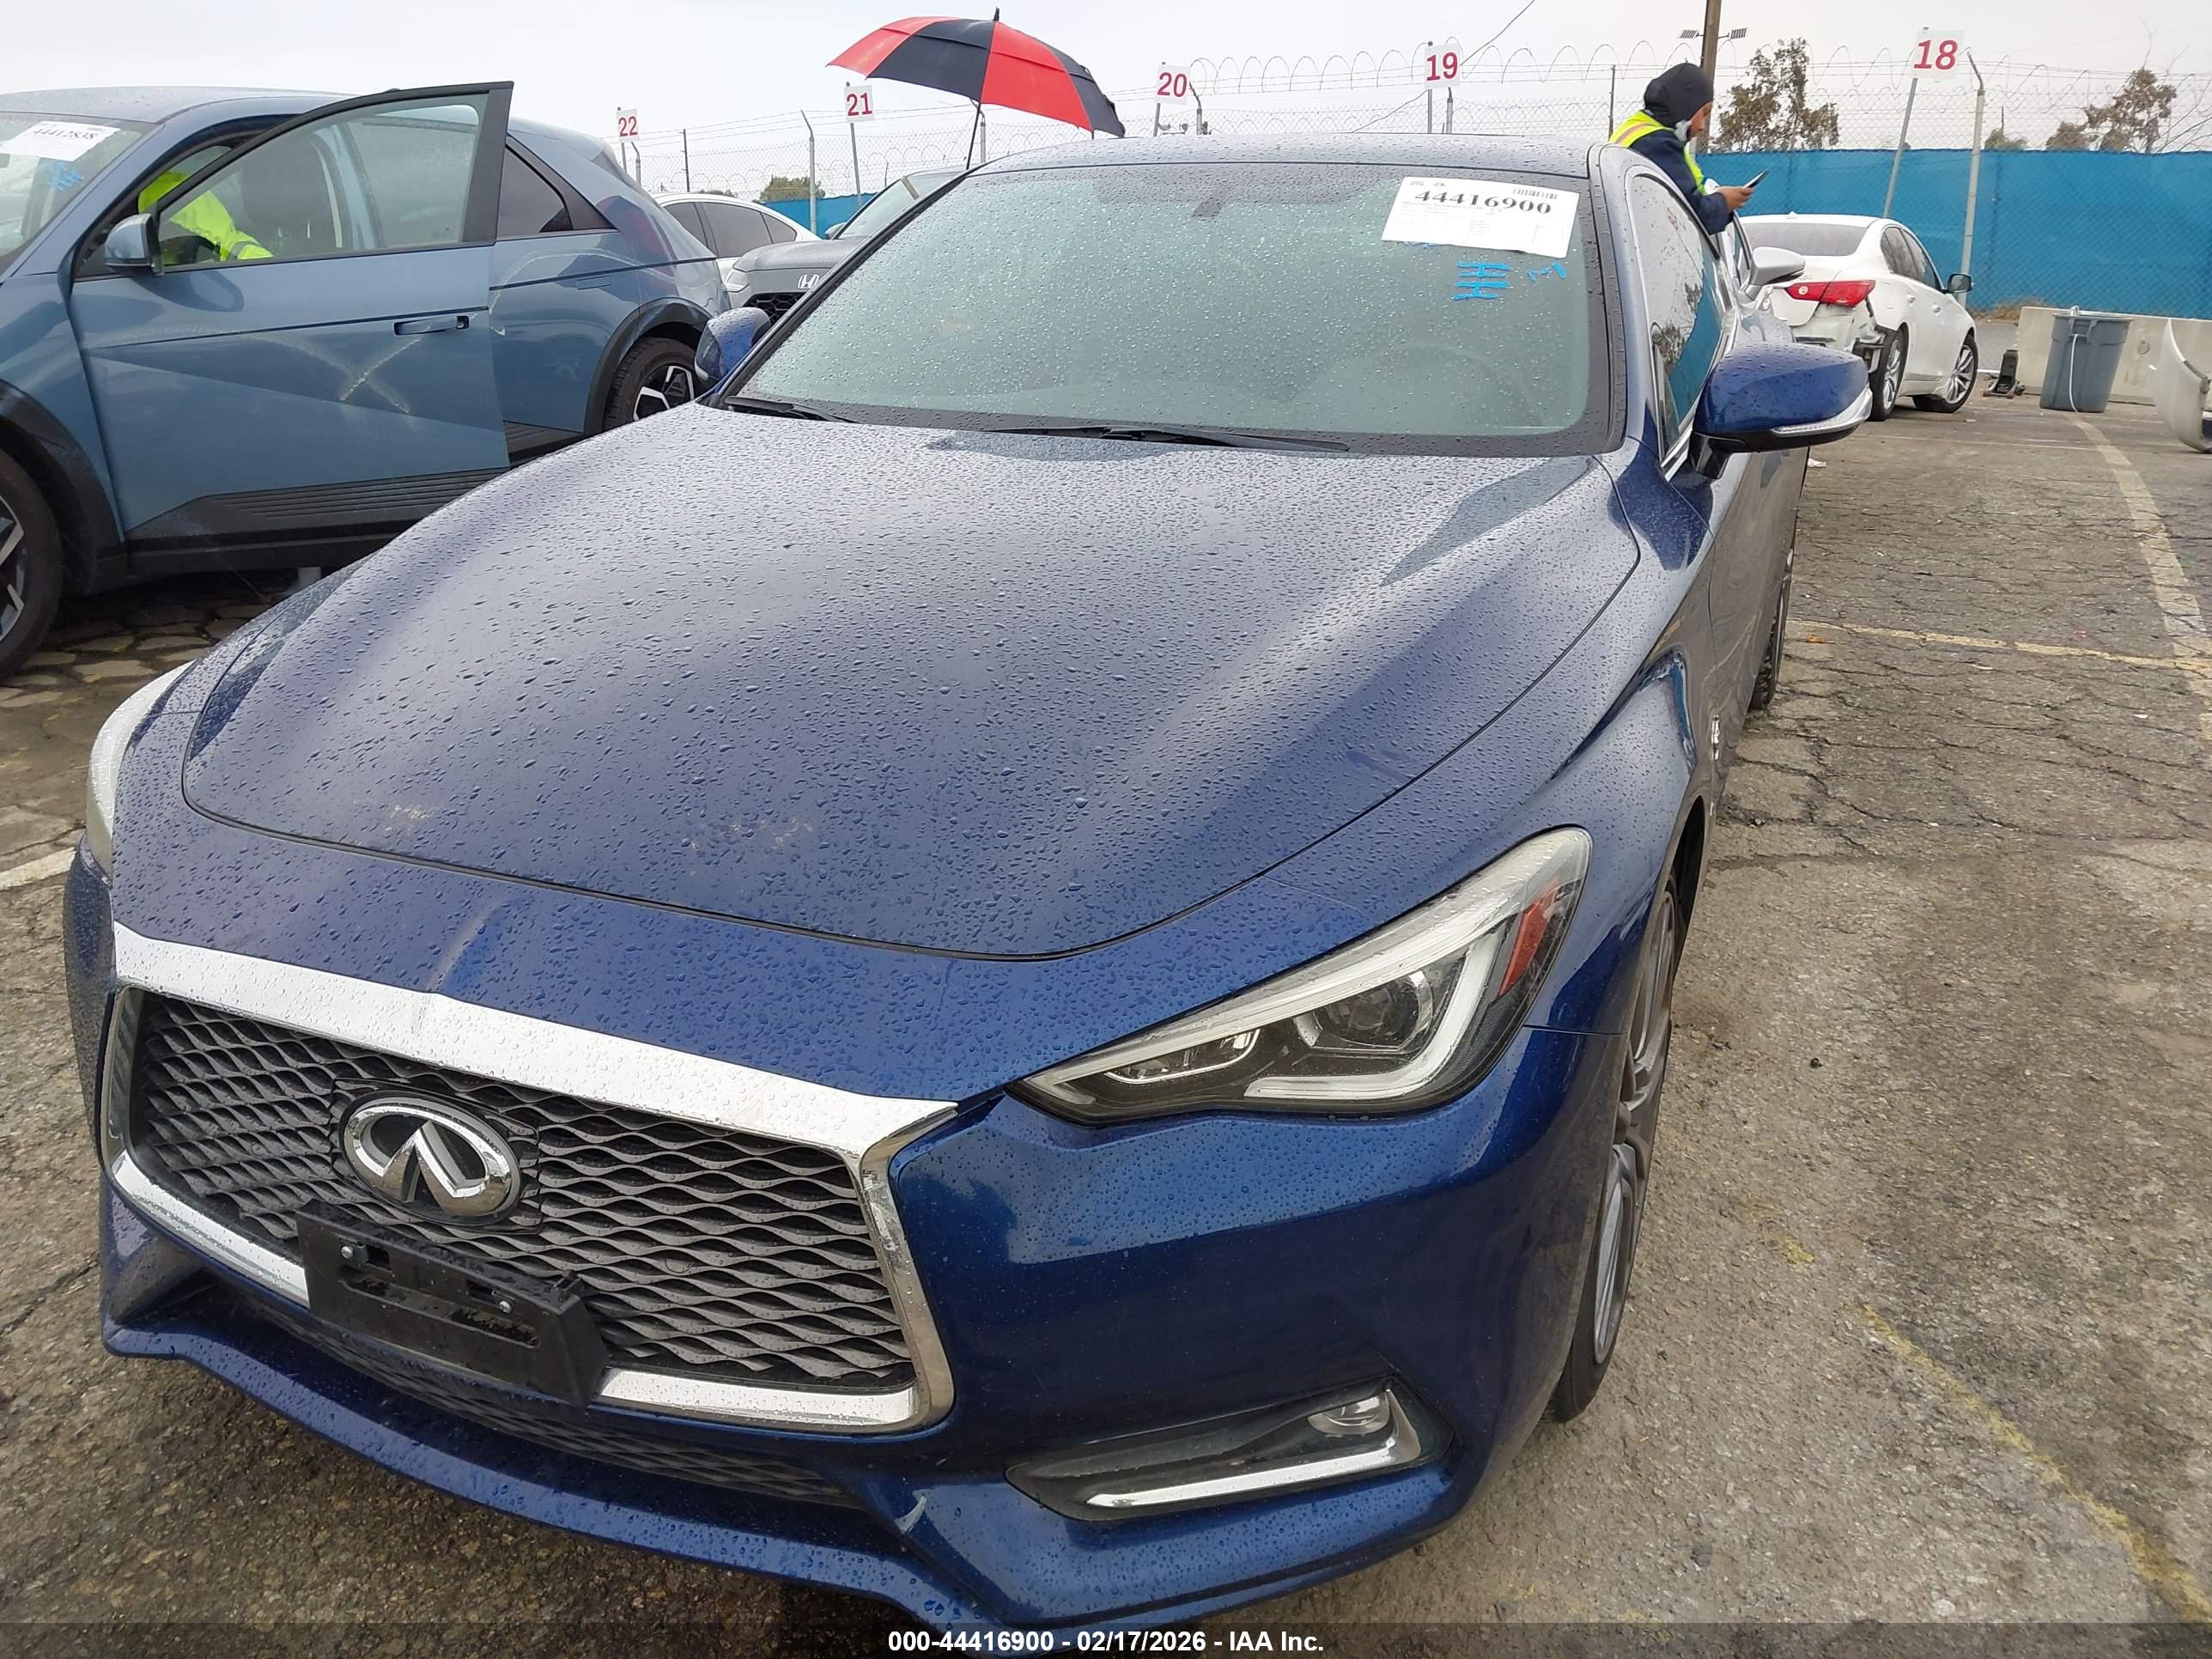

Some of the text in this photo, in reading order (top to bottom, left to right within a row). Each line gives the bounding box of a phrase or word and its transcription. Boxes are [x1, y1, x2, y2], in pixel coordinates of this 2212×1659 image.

[1426, 52, 1458, 81] 19
[1913, 40, 1958, 70] 18
[1157, 72, 1187, 97] 20
[847, 92, 872, 116] 21
[618, 116, 638, 137] 22
[1414, 190, 1552, 214] 44416900
